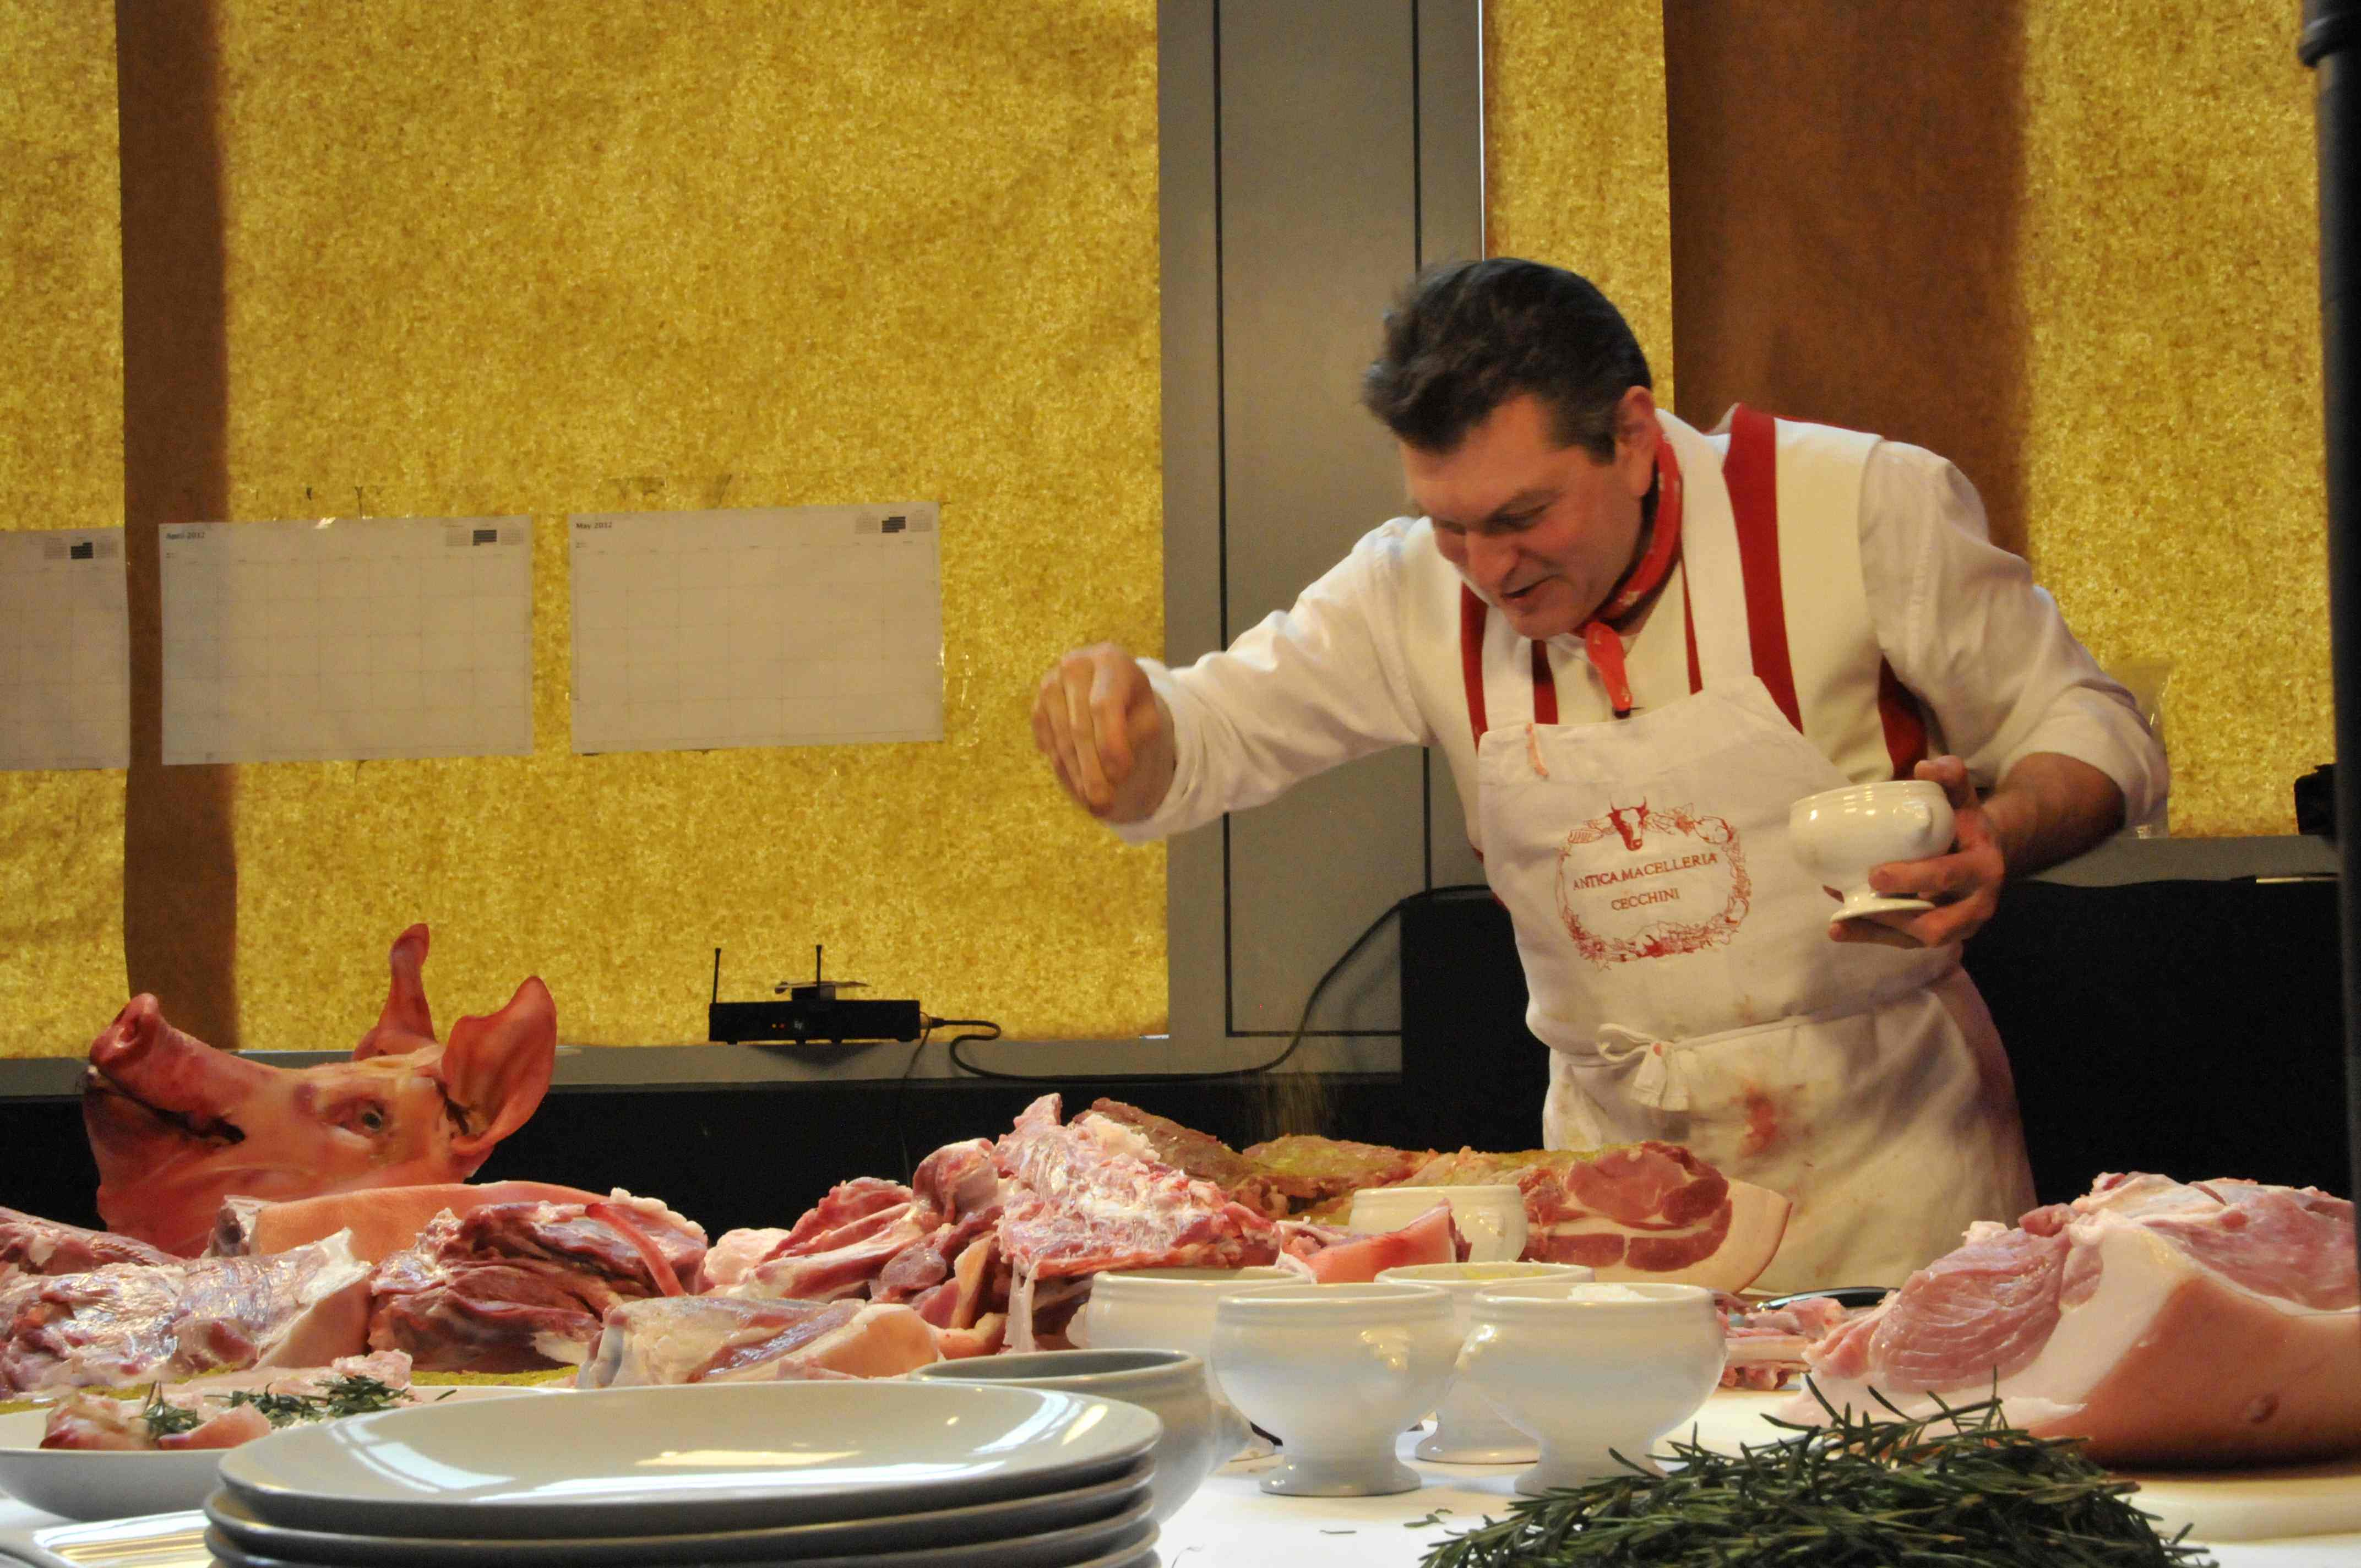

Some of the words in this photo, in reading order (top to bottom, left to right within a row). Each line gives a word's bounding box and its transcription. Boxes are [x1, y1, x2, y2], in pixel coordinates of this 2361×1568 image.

[187, 531, 205, 540] 2012
[1573, 872, 1618, 890] ANTICA
[1621, 853, 1717, 881] MACELLERIA
[1611, 888, 1680, 911] CECCHINI
